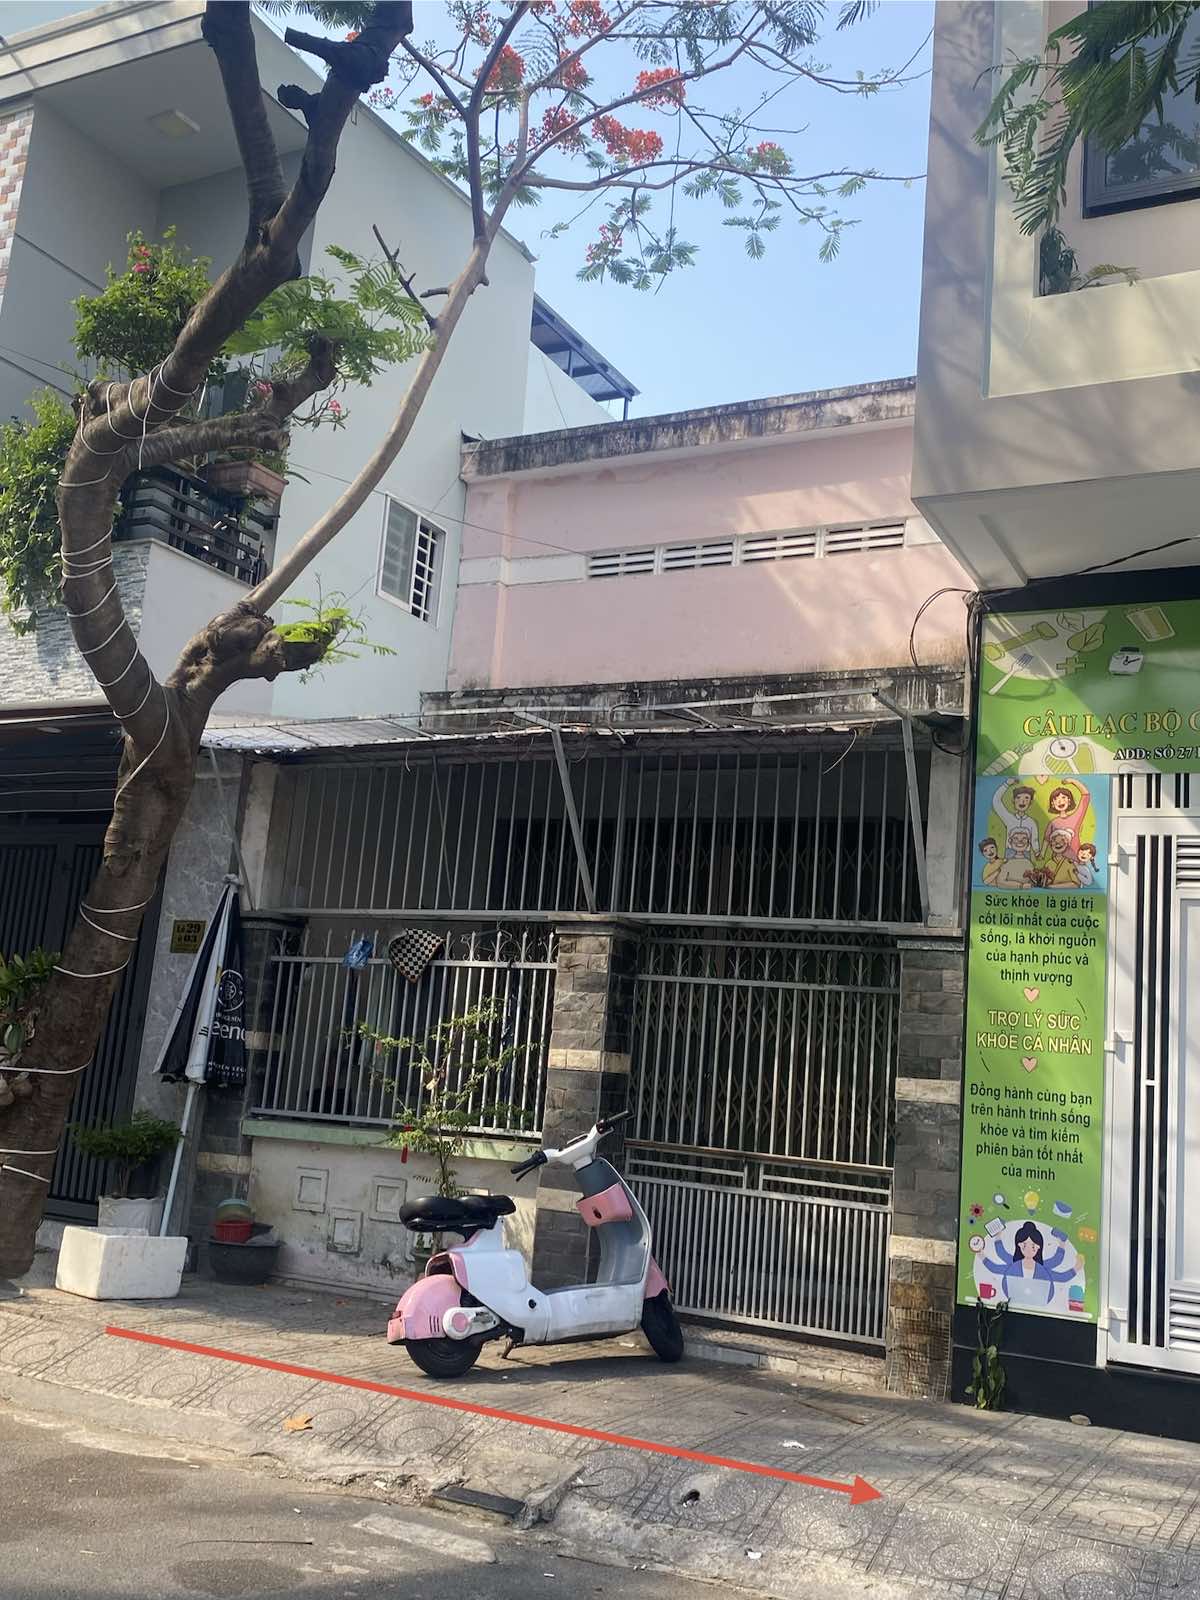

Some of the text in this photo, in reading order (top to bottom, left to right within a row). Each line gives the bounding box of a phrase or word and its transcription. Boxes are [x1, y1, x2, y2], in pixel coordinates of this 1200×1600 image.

[1023, 709, 1077, 737] CÂU
[1084, 712, 1137, 739] LẠC
[1144, 709, 1182, 737] BỘ
[1114, 744, 1192, 760] ADD: SỐ 27
[985, 894, 1093, 912] Sức khỏe là giá trị
[979, 911, 1099, 930] cốt lõi nhất của cuộc
[1016, 932, 1024, 944] là
[1029, 933, 1054, 944] khởi
[1059, 932, 1096, 948] nguồn
[986, 949, 1088, 966] của hạnh phúc và
[1000, 969, 1072, 986] thịnh vượng
[988, 1009, 1080, 1030] TRỢ LÝ SỨC
[977, 1030, 1091, 1054] KHỎE CÁ NHÂN
[971, 1081, 1092, 1108] Đồng hành cùng bạn
[971, 1104, 1090, 1127] trên hành trình sống
[980, 1122, 1079, 1143] khỏe và tìm kiếm
[976, 1142, 1083, 1164] phiên bản tốt nhất
[1002, 1164, 1055, 1180] của mình
